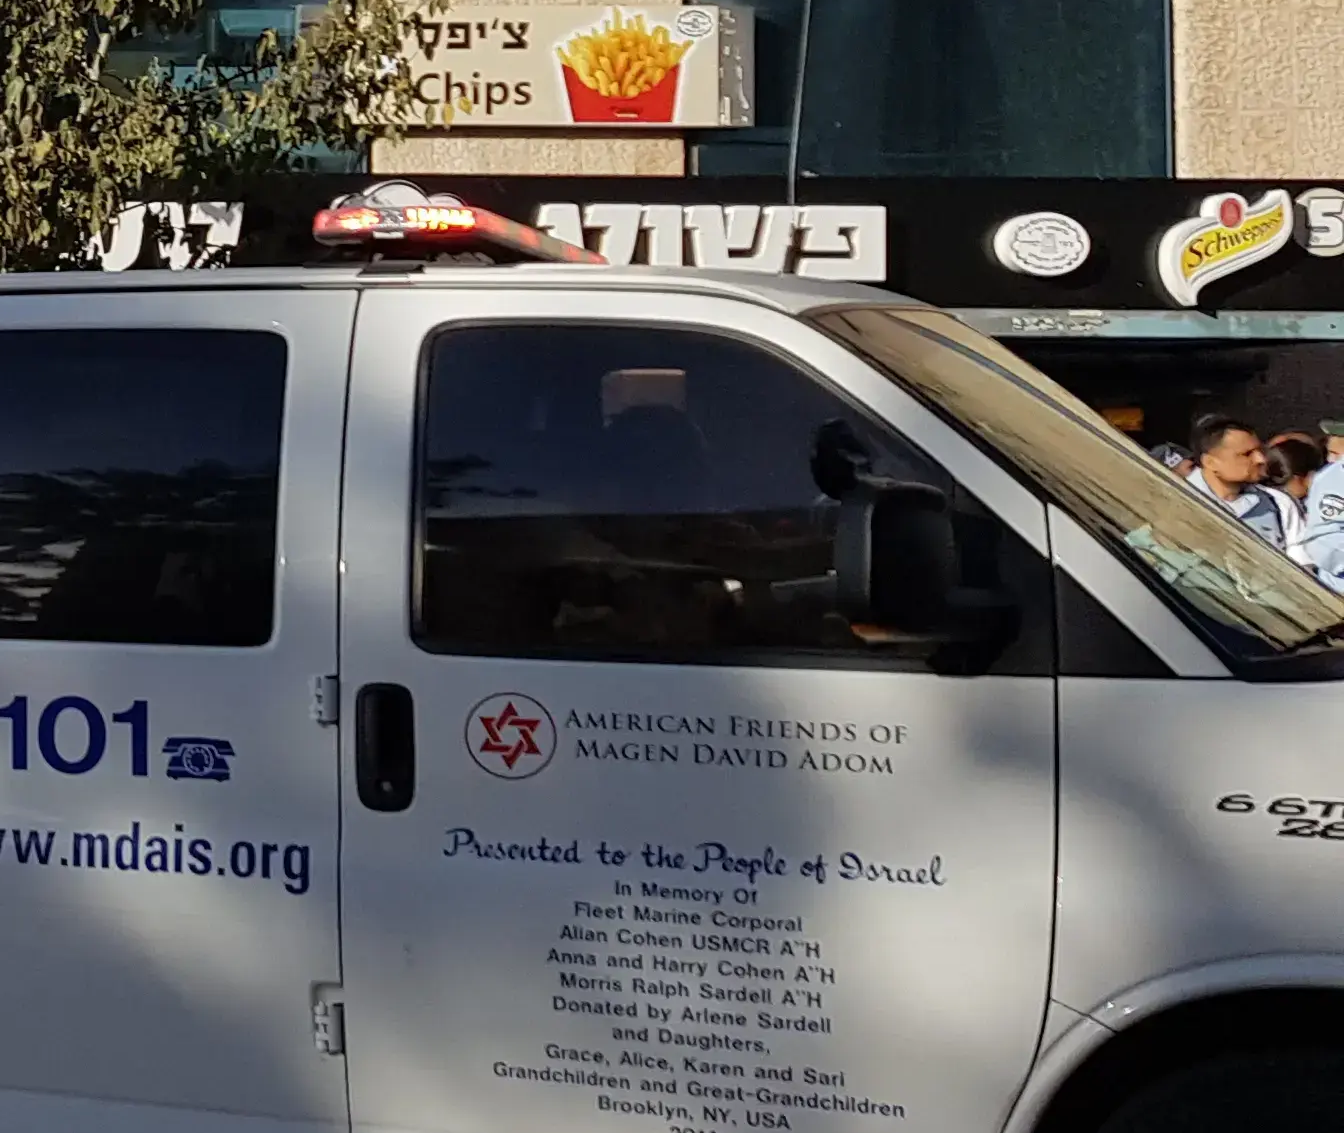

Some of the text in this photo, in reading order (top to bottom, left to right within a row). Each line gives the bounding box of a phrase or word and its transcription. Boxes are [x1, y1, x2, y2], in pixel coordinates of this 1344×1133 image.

[413, 71, 533, 115] Chips
[563, 708, 716, 735] AMERICAN
[727, 714, 858, 742] FRIENDS
[575, 739, 894, 775] MAGEN DAVID ADOM
[443, 827, 951, 886] Presented to the People of Israel
[614, 880, 759, 906] In Memory Of
[574, 900, 804, 933] Fleet Marine Corporal
[559, 923, 609, 944] Allan
[617, 928, 684, 950] Cohen
[692, 933, 772, 956] USMCR
[546, 947, 598, 967] Anna
[606, 953, 644, 971] and
[652, 953, 709, 978] Harry
[717, 959, 786, 982] Cohen
[559, 971, 623, 994] Morris
[631, 977, 691, 1000] Ralph
[698, 982, 773, 1006] Sardell
[552, 995, 833, 1035] Donated by Arlene Sardell
[612, 1027, 772, 1056] and Daughters,
[545, 1043, 611, 1068] Grace,
[619, 1050, 675, 1074] Alice,
[683, 1055, 746, 1079] Karen
[753, 1065, 794, 1084] and
[492, 1061, 907, 1119] Grandchildren and Great-Grandchildren
[597, 1094, 793, 1132] Brooklyn, NY, USA
